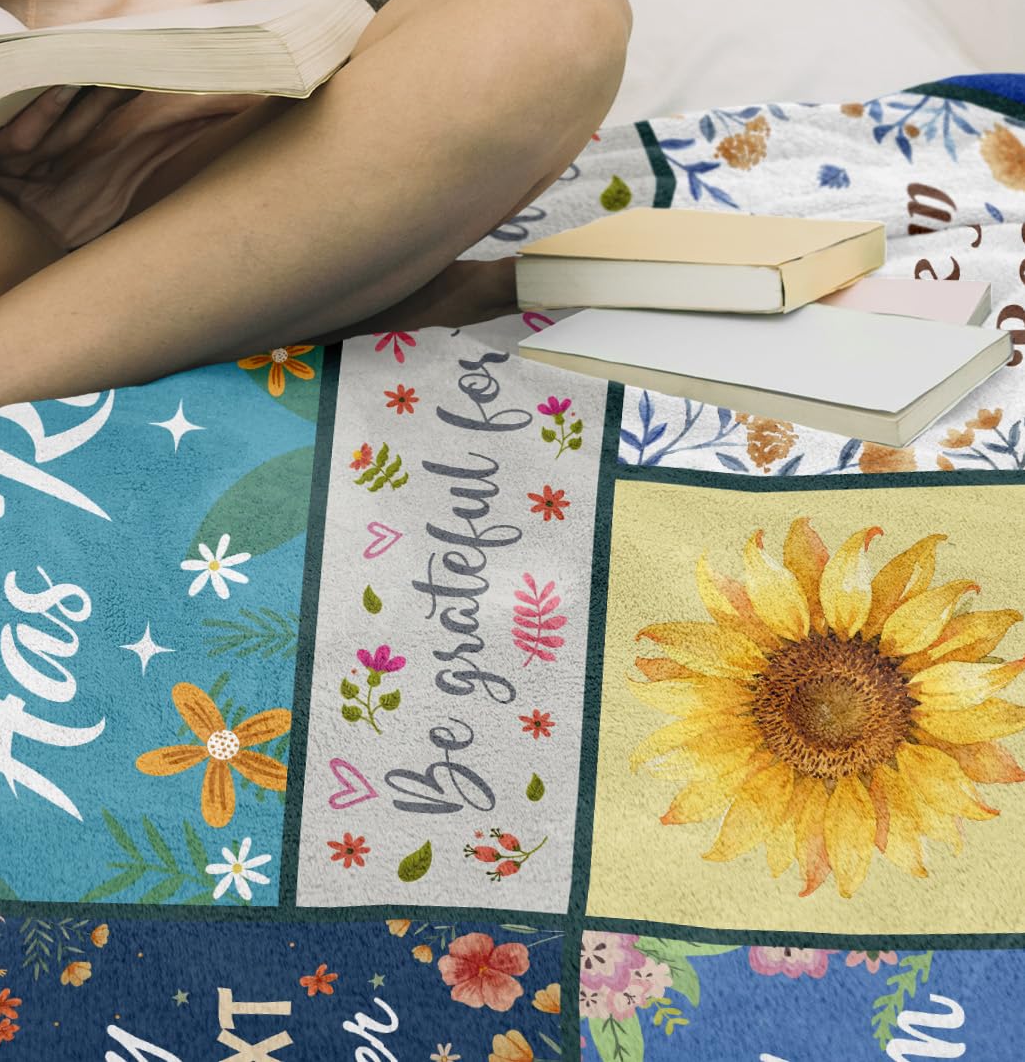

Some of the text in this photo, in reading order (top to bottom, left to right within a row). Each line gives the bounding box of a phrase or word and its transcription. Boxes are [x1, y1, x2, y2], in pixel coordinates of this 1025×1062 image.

[384, 350, 533, 815] Be grateful for
